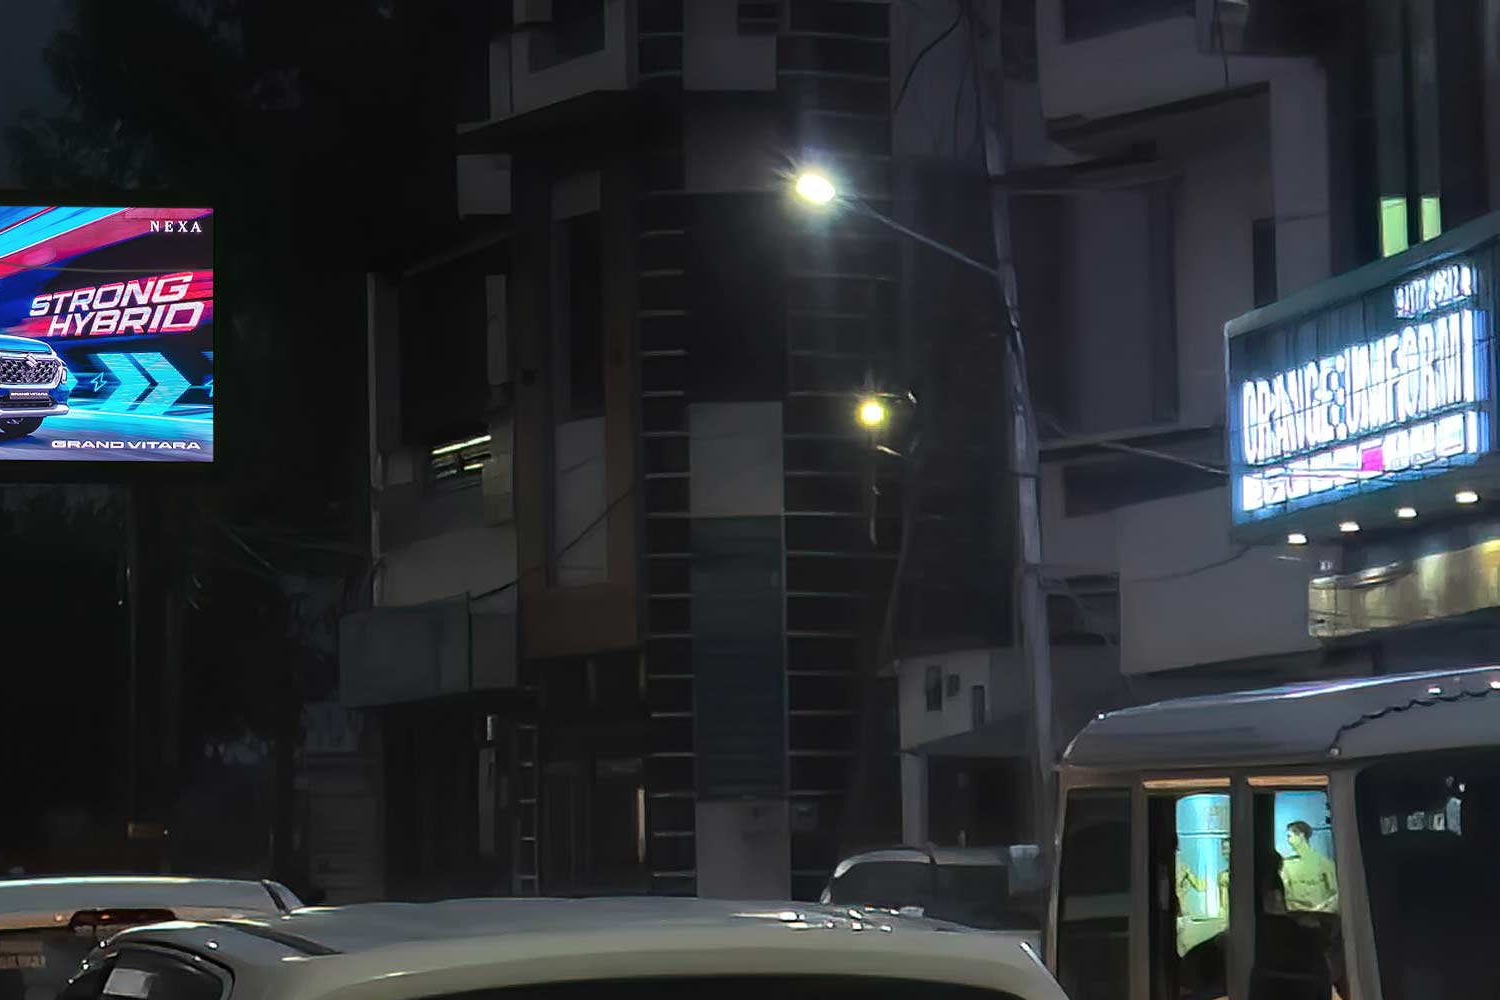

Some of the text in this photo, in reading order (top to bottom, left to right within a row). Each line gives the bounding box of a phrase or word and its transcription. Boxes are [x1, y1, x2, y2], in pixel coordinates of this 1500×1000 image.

[149, 220, 202, 233] NEXA
[29, 272, 193, 317] STRONG
[47, 301, 204, 337] HYBRID
[51, 440, 201, 450] GRAND VITARA
